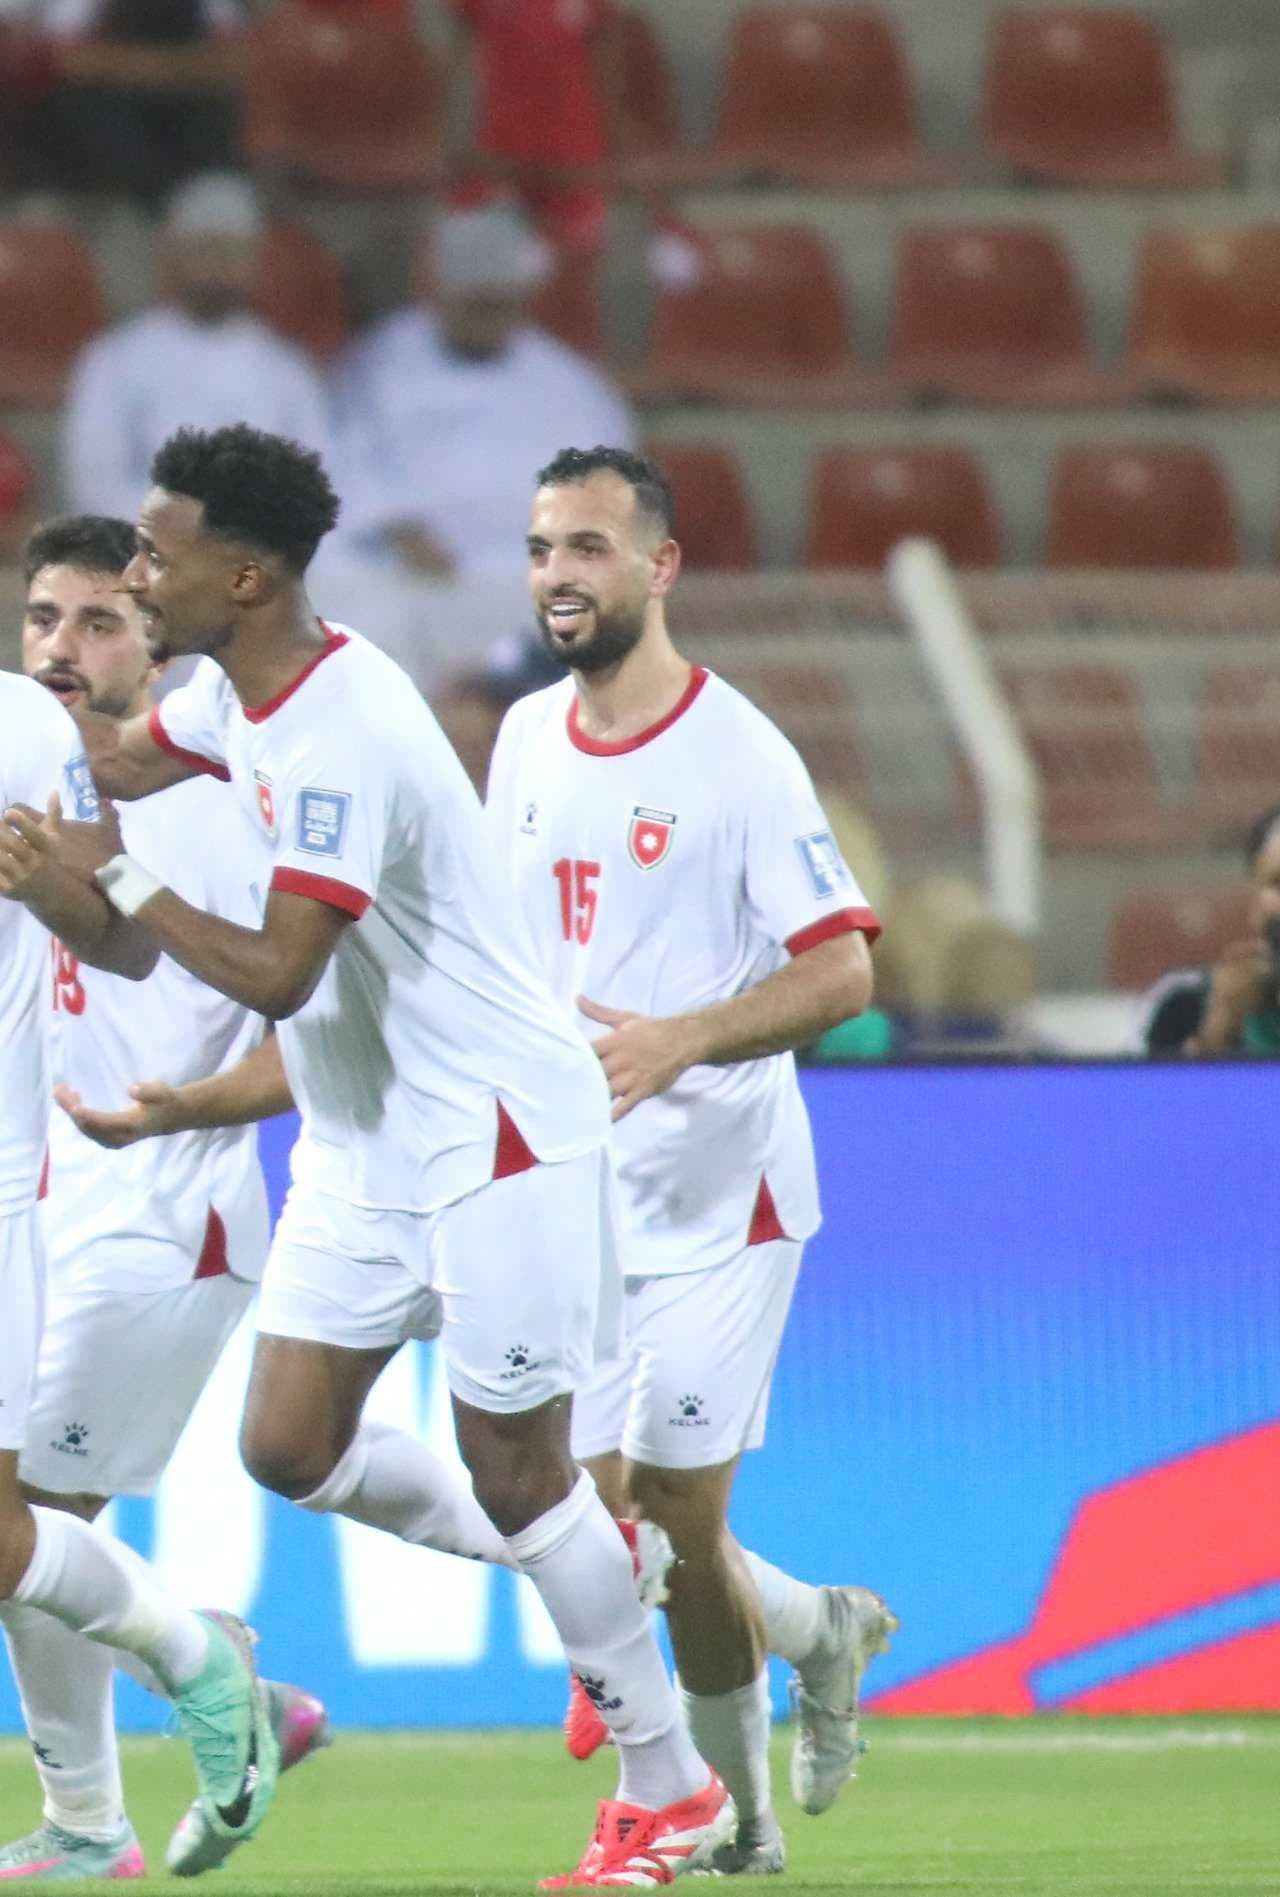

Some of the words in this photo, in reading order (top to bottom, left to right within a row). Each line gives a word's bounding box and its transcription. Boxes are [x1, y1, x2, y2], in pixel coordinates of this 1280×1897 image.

[553, 857, 600, 945] 15
[52, 934, 87, 1016] 9
[668, 1417, 710, 1427] KELME
[50, 1440, 88, 1457] KELME
